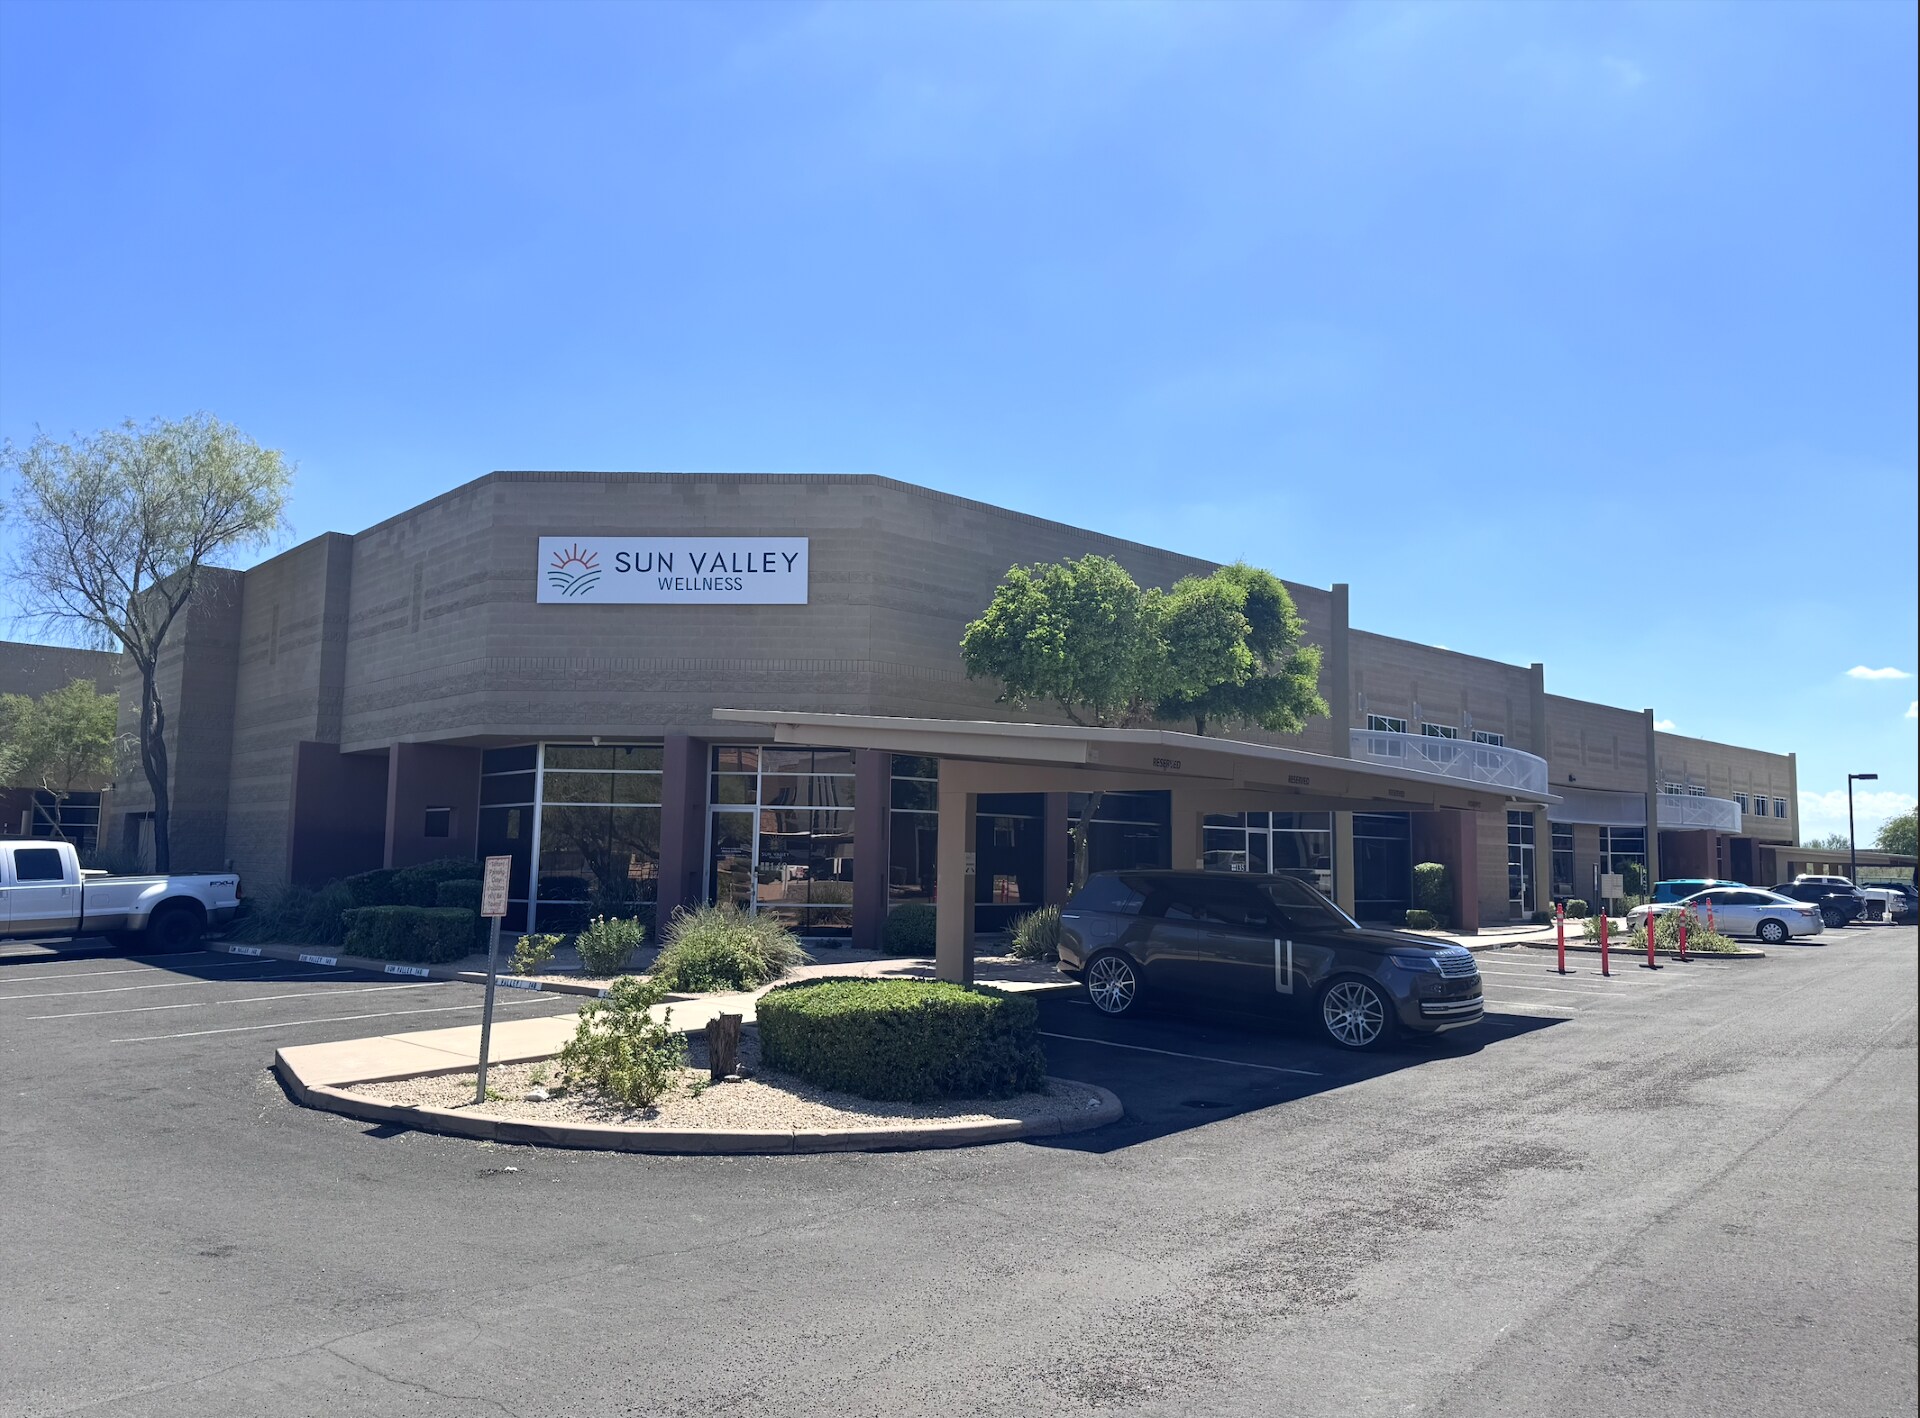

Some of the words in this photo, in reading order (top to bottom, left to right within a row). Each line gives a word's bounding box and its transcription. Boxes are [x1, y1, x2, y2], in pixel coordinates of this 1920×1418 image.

[615, 551, 674, 573] SUN
[689, 551, 799, 574] VALLEY
[658, 577, 743, 591] WELLNESS
[1152, 758, 1181, 769] RESERVED
